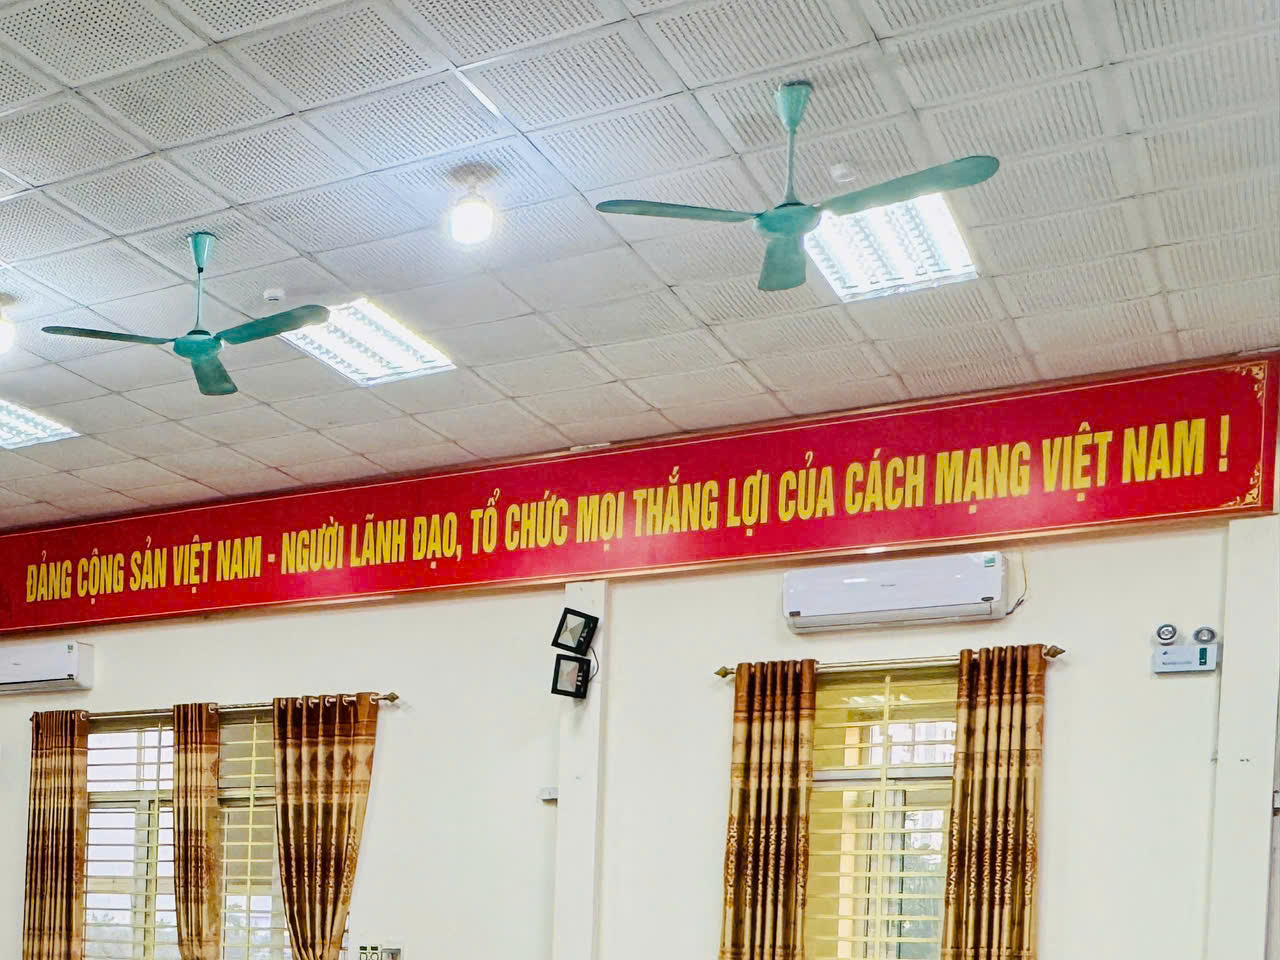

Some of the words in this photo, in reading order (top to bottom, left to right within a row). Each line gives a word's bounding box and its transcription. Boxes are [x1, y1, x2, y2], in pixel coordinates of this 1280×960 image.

[26, 550, 72, 602] ĐẢNG
[77, 547, 124, 605] CỘNG
[130, 536, 167, 591] SẢN
[173, 534, 212, 593] VIỆT
[216, 536, 262, 582] NAM
[267, 553, 275, 563] -
[281, 516, 345, 575] NGƯỜI
[350, 513, 406, 567] LÃNH
[412, 512, 462, 569] ĐẠO,
[470, 488, 500, 554] TỔ
[504, 490, 569, 551] CHỨC
[576, 491, 625, 552] MỌI
[632, 466, 719, 537] THẮNG
[726, 470, 770, 537] LỢI
[778, 451, 835, 522] CỦA
[845, 448, 925, 515] CÁCH
[934, 441, 1031, 514] MẠNG
[1042, 421, 1113, 502] VIỆT
[1122, 418, 1206, 484] NAM
[1219, 414, 1230, 472] !
